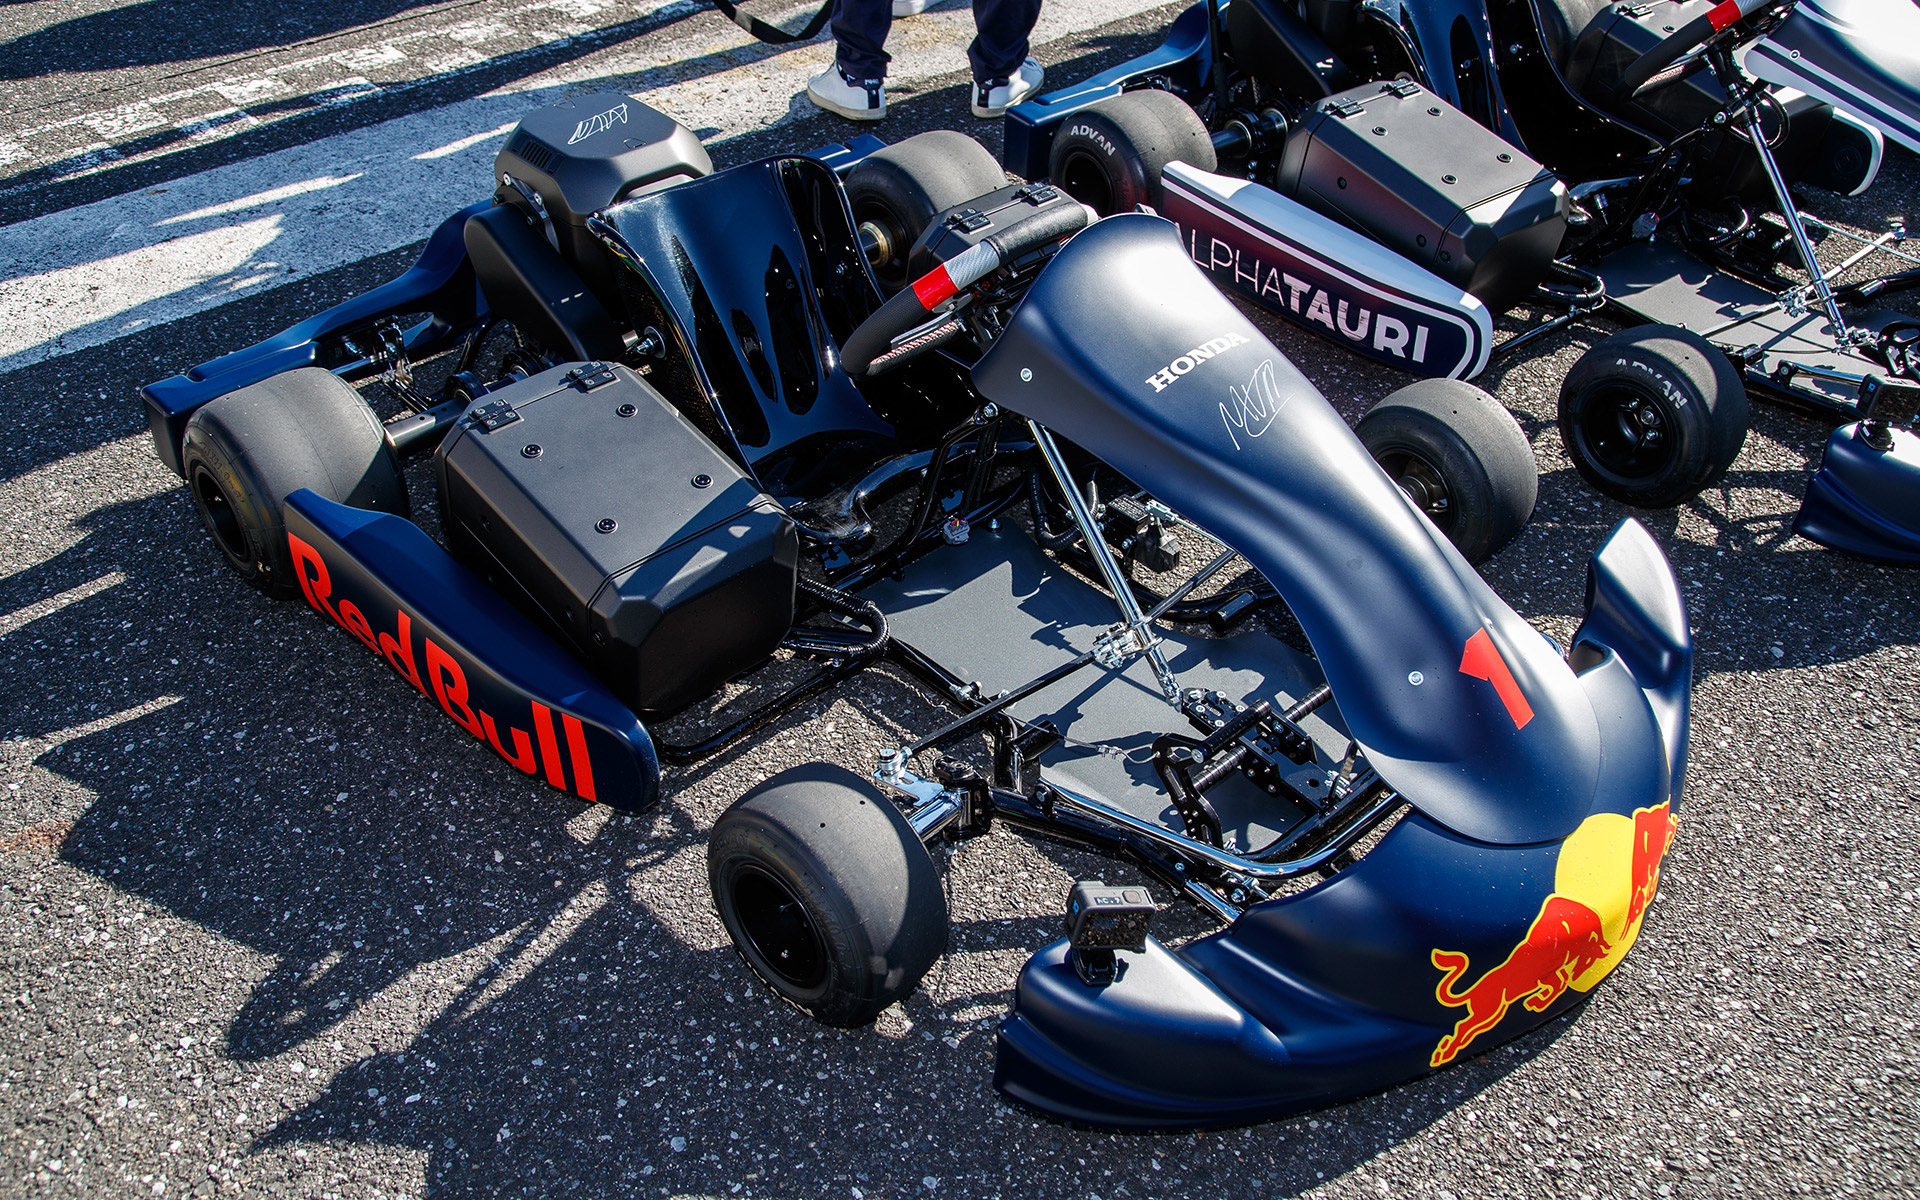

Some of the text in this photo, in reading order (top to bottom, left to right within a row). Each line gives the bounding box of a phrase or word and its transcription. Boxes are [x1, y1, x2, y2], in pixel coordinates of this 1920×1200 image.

[1070, 125, 1116, 156] ADVAN
[1145, 331, 1251, 393] HONDA
[287, 531, 597, 802] Red Bull
[1459, 626, 1535, 730] 1
